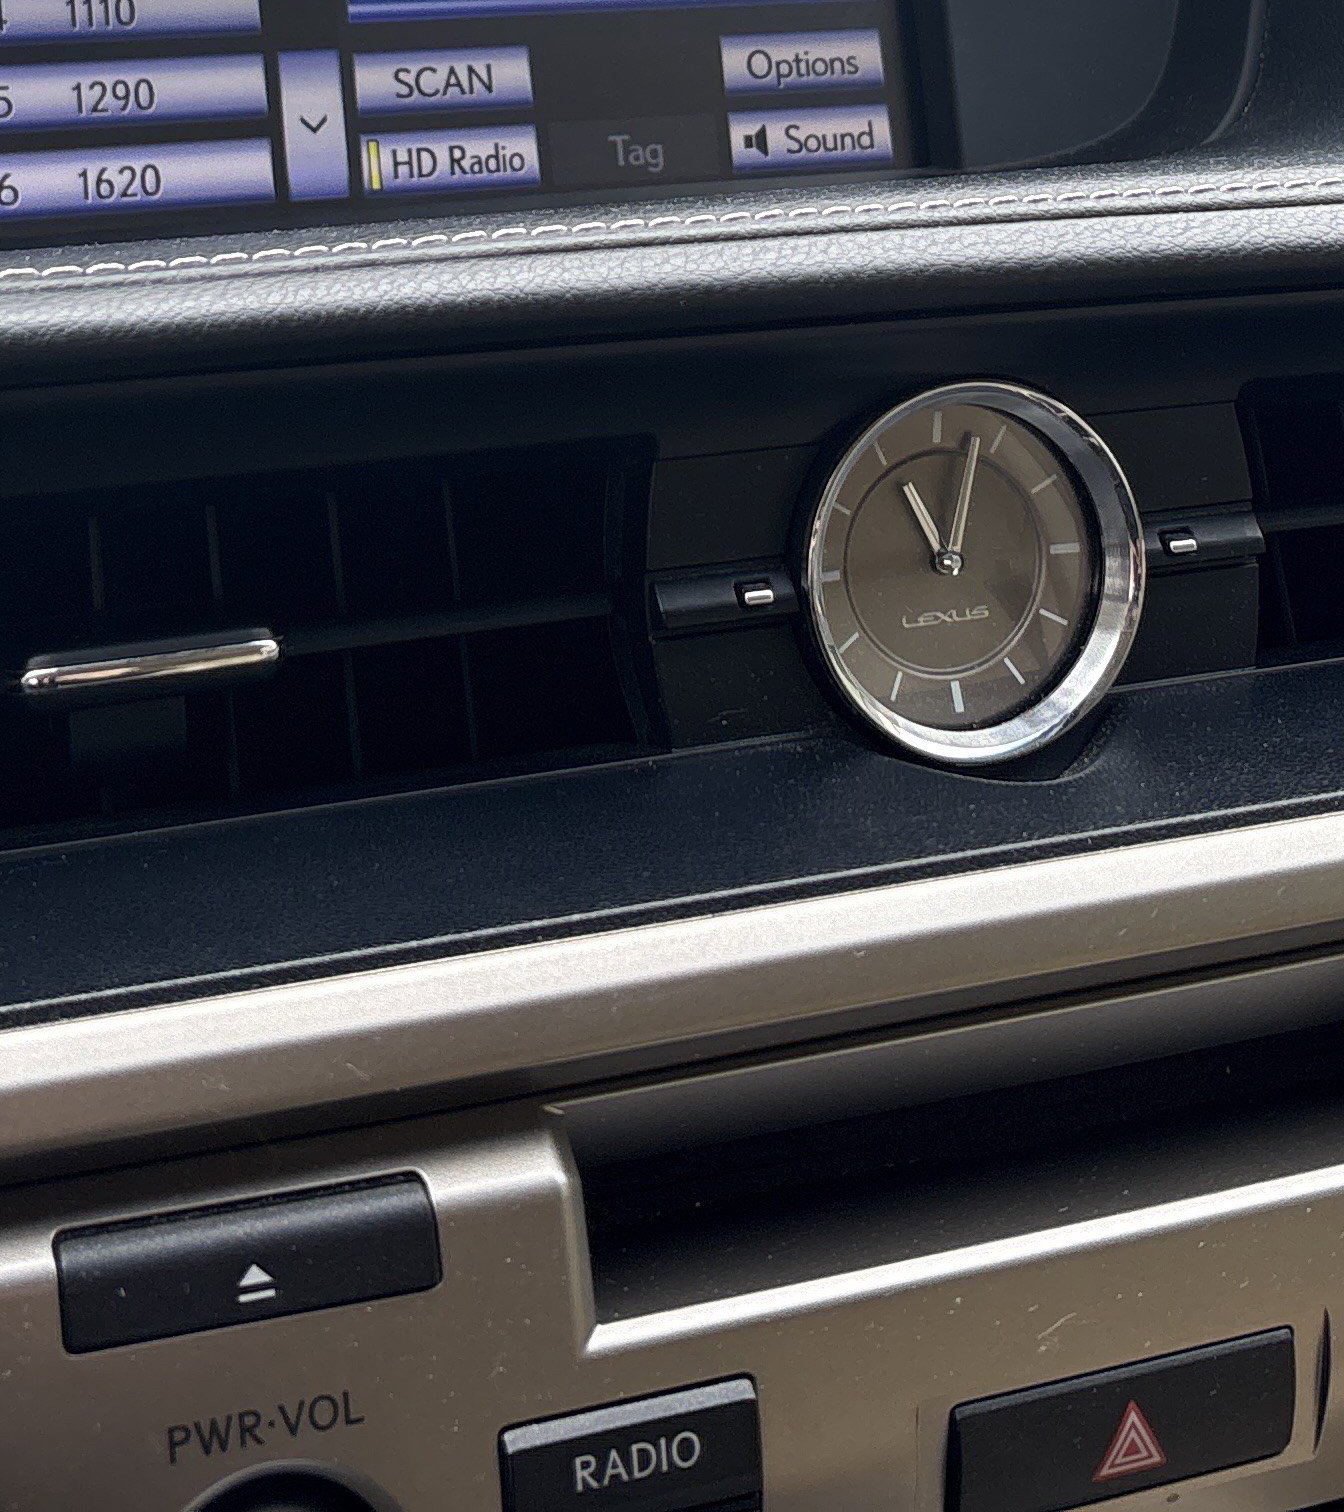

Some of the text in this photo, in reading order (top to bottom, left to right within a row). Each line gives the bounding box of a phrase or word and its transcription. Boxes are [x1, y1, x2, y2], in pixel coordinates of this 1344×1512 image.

[393, 63, 494, 99] SCAN
[746, 49, 860, 88] Options
[72, 79, 156, 116] 1290
[607, 134, 665, 170] Tag
[784, 120, 875, 155] Sound
[391, 144, 525, 180] HD Radio
[78, 164, 162, 201] 1620
[902, 605, 989, 628] LEXUS
[575, 1432, 702, 1491] RADIO
